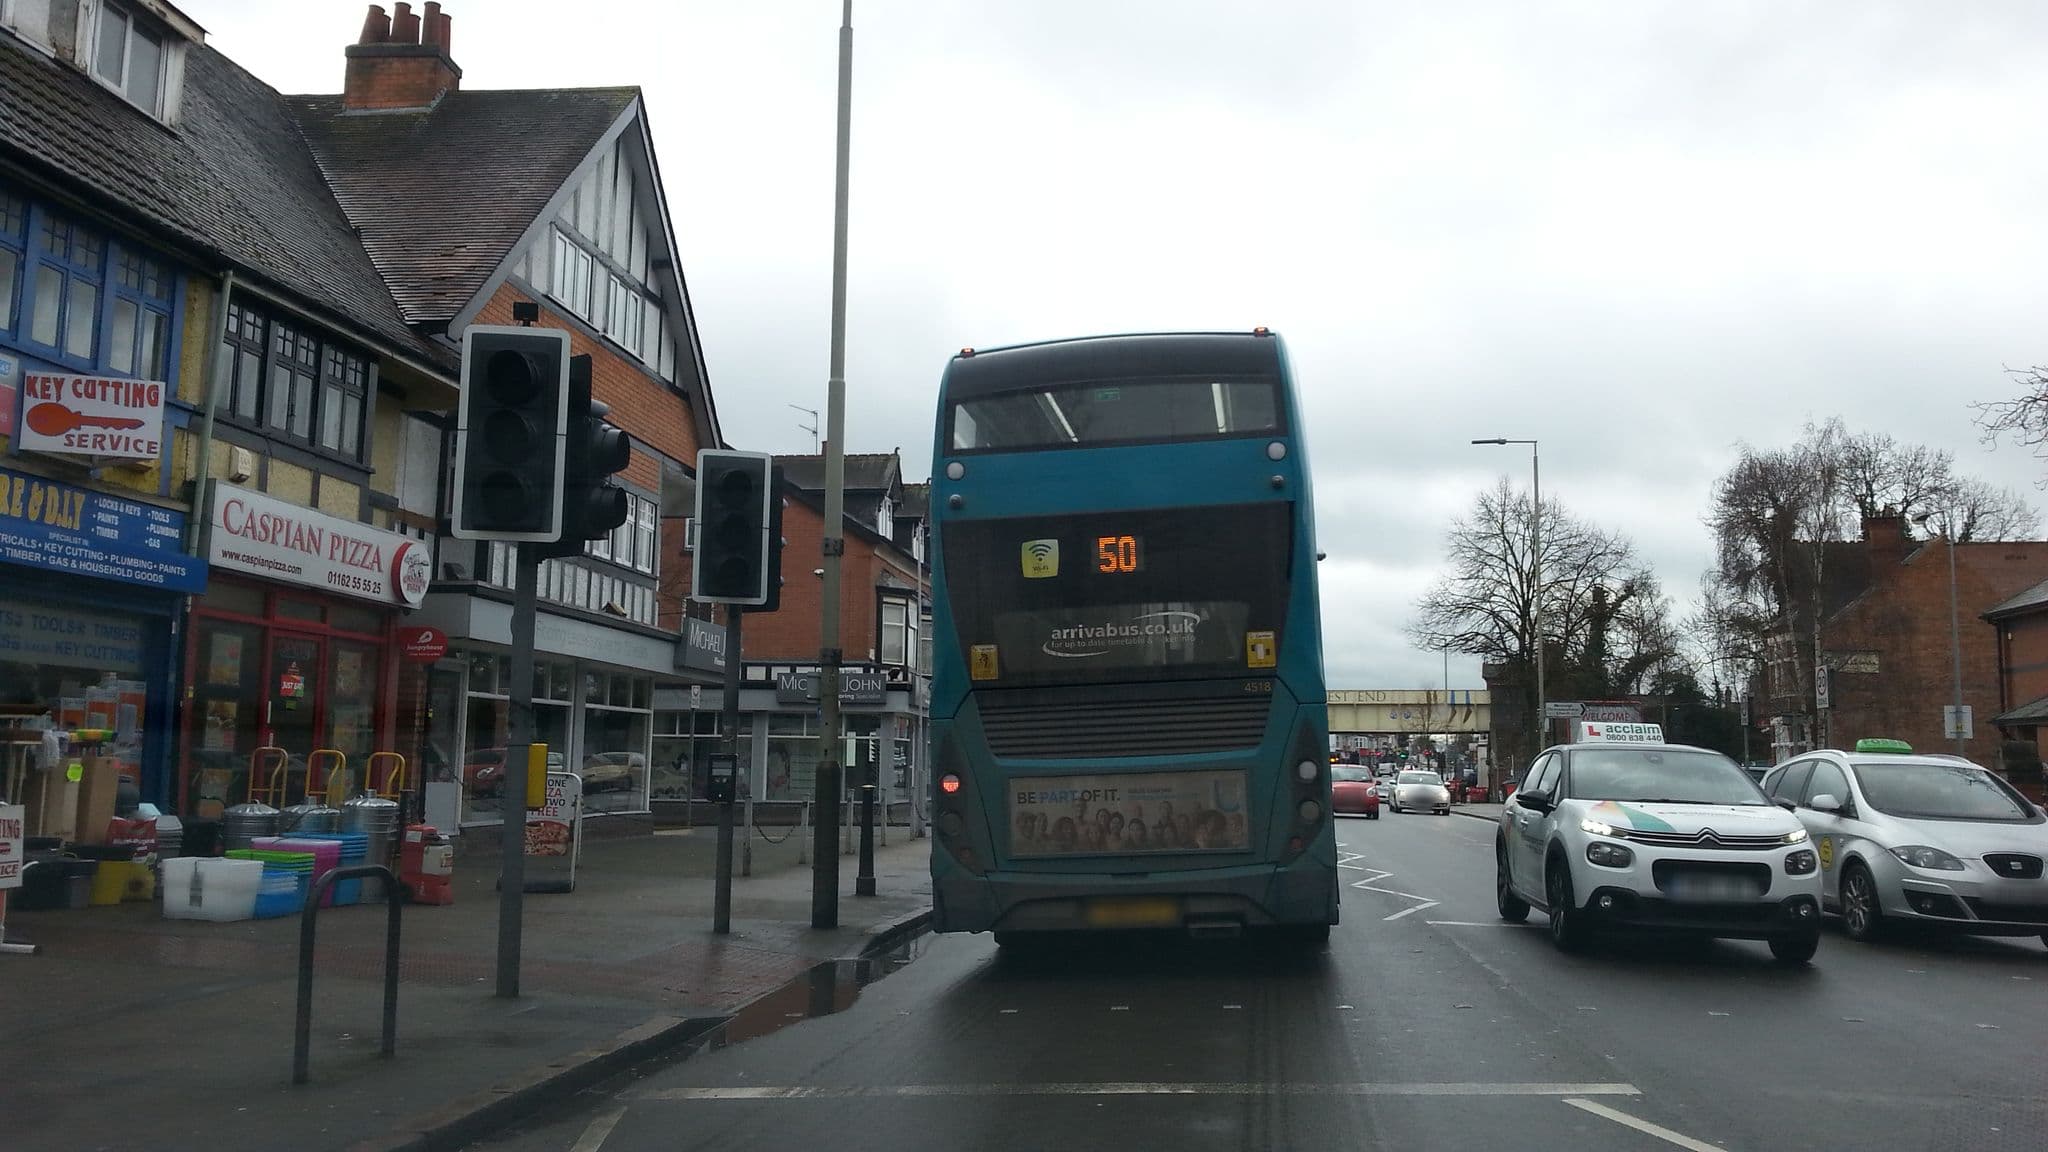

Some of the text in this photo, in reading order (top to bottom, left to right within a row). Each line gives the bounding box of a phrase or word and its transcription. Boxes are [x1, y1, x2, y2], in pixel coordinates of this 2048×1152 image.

[26, 375, 159, 408] KEY CUTTING
[64, 434, 158, 454] SERVICE
[0, 473, 25, 517] RE
[98, 498, 118, 512] LOCKS
[125, 503, 141, 517] KEYS
[97, 512, 119, 526] PAINTS
[151, 510, 170, 524] TOOLS
[96, 526, 119, 540] TIMBER
[149, 524, 179, 539] PLUMBING
[223, 499, 383, 573] CASPIAN PIZZA
[148, 538, 161, 549] GAS
[44, 542, 64, 555] KEY
[65, 546, 104, 562] CUTTING
[110, 554, 153, 571] PLUMBING
[158, 563, 186, 577] PAINTS
[221, 548, 302, 575] www.caspianpizza.com
[1098, 535, 1137, 573] 50
[5, 547, 164, 583] TIMBER GAS & HOUSEHOLD GOODS
[327, 570, 382, 595] 01162 55 55 25
[1051, 619, 1194, 640] arrivabus.co.uk
[689, 622, 721, 653] MICHAEL
[1051, 640, 1063, 648] for
[1065, 641, 1076, 649] up
[1077, 639, 1086, 648] to
[281, 681, 293, 690] JUST
[1244, 682, 1272, 693] 4518
[1358, 690, 1386, 702] END
[1588, 725, 1601, 737] L
[1606, 724, 1660, 734] acclaim
[1606, 734, 1627, 742] 0800
[1629, 734, 1644, 742] 838
[1017, 791, 1037, 804] BE
[1040, 790, 1077, 803] PART
[1080, 789, 1103, 802] OF
